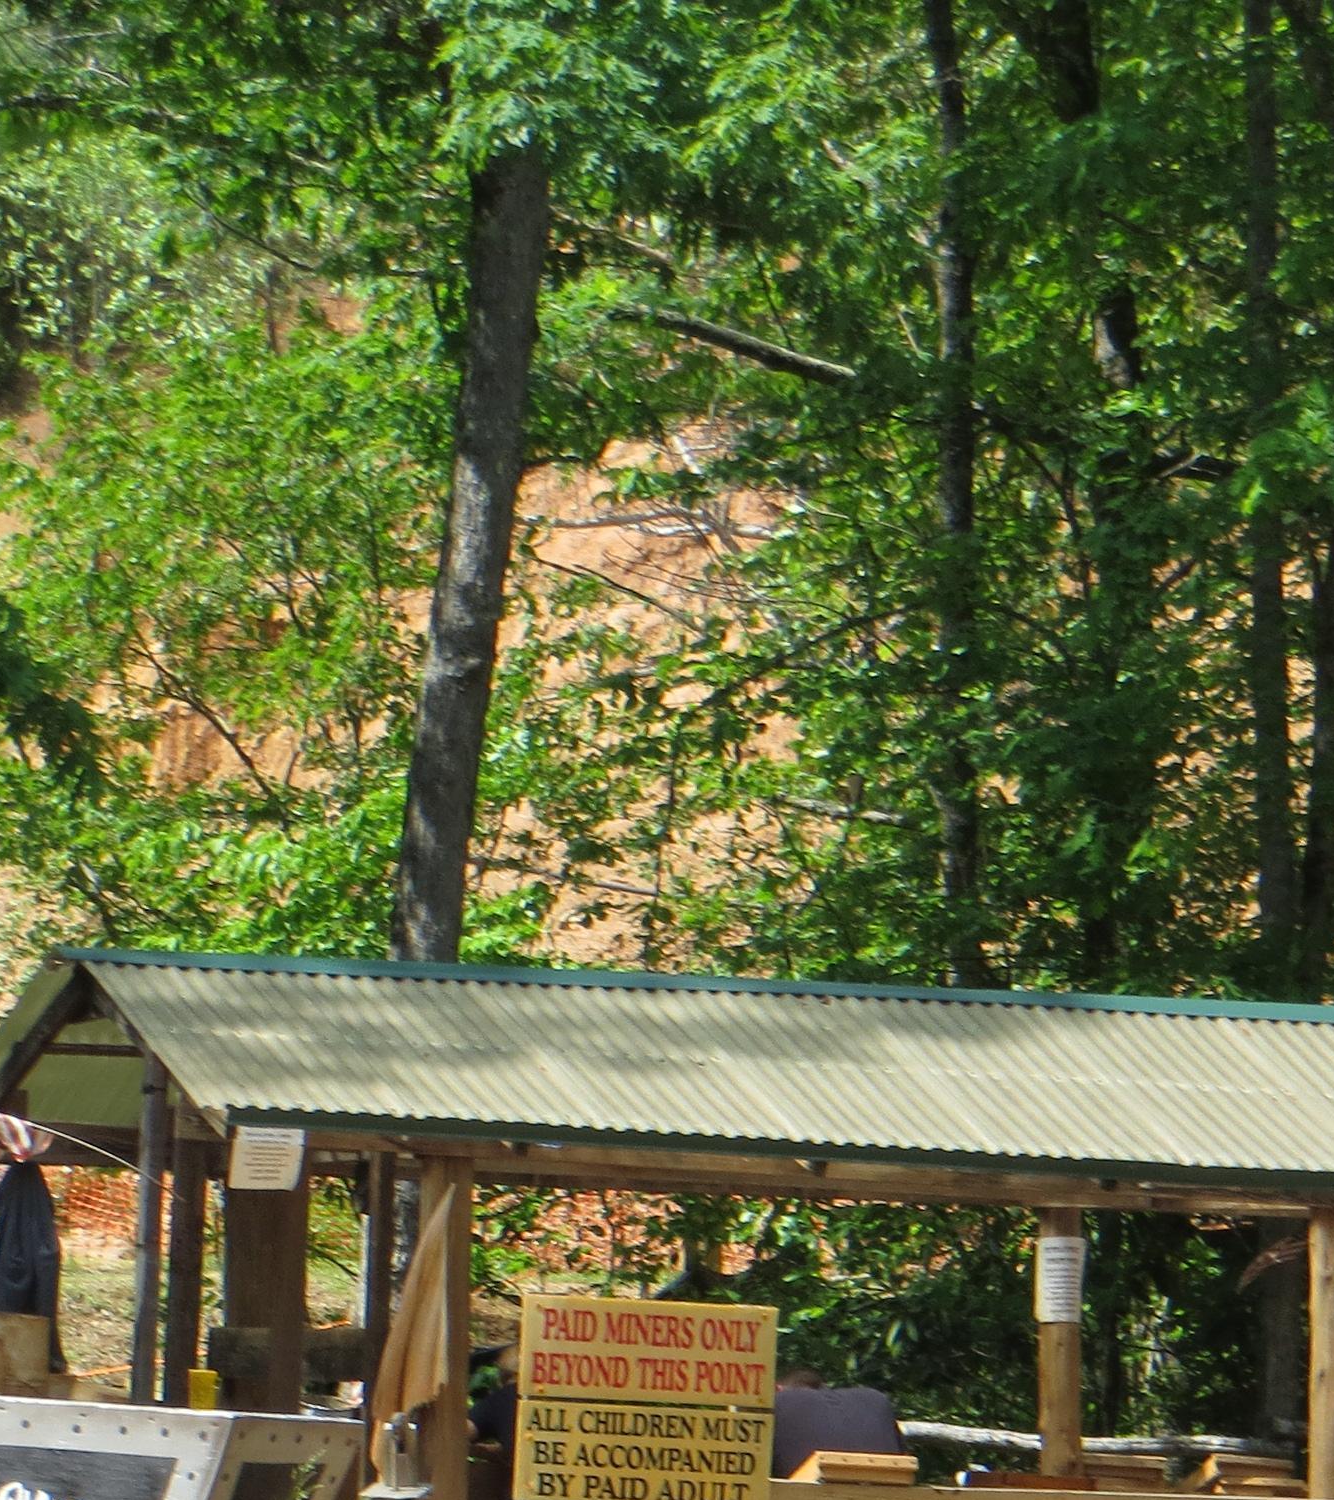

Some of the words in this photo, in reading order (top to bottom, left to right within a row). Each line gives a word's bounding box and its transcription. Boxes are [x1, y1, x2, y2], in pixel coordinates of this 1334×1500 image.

[542, 1307, 598, 1342] PAID
[605, 1312, 695, 1349] MINERS
[701, 1318, 761, 1353] ONLY
[531, 1352, 629, 1389] BEYOND
[636, 1358, 689, 1392] THIS
[694, 1361, 765, 1396] POINT
[527, 1408, 571, 1433] ALL
[578, 1410, 697, 1439] CHILDREN
[702, 1417, 766, 1443] MUST
[533, 1441, 566, 1465] BE
[572, 1443, 756, 1476] ACCOMPANIED
[537, 1472, 575, 1498] BY
[583, 1476, 648, 1500] PAID
